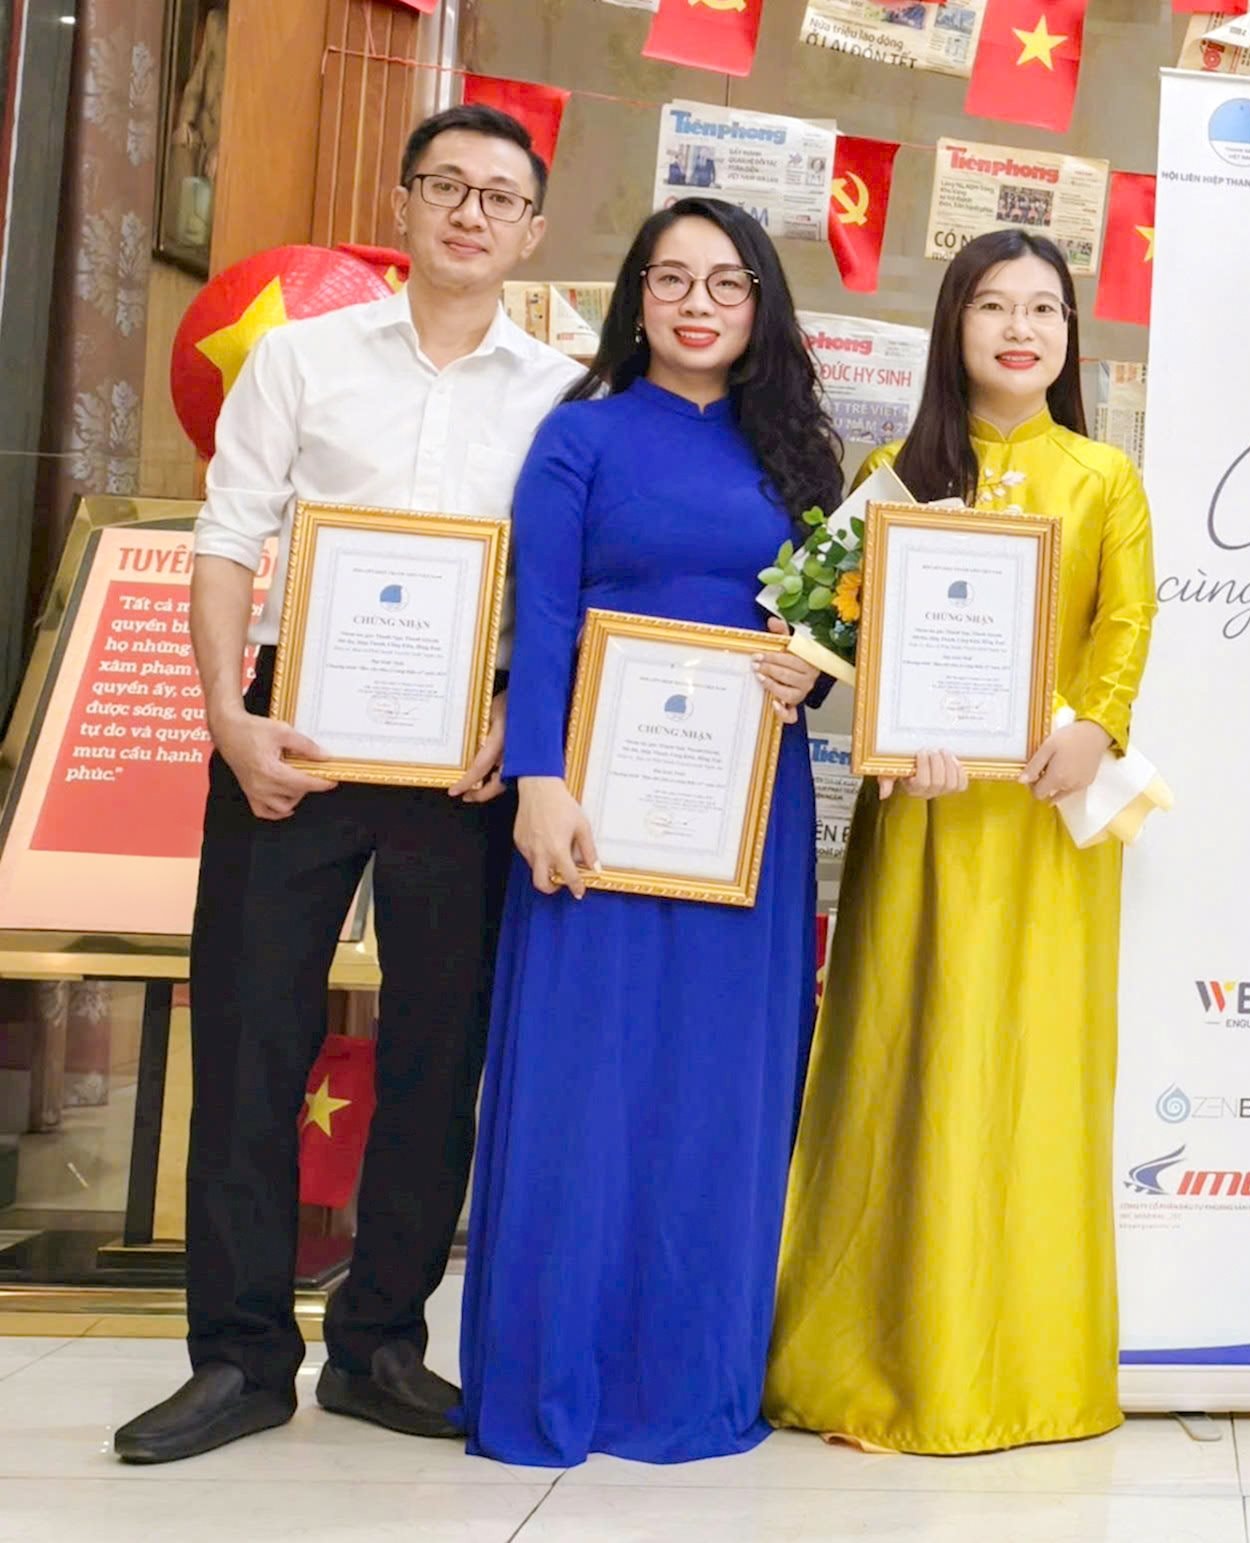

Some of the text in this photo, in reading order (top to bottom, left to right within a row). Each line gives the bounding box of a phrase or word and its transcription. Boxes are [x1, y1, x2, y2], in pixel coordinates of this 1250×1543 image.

[859, 29, 875, 43] lao
[1161, 171, 1178, 181] HỘI
[1180, 171, 1200, 183] LIÊN
[1203, 175, 1224, 186] HIỆP
[853, 367, 875, 384] HY
[877, 368, 912, 387] SINH
[154, 597, 173, 613] cả
[105, 637, 191, 657] họ những
[99, 659, 192, 677] xâm phạm
[181, 684, 201, 698] có
[86, 700, 130, 716] được
[80, 723, 101, 738] tự
[104, 723, 126, 738] do
[130, 725, 151, 739] và
[156, 748, 203, 764] hạnh
